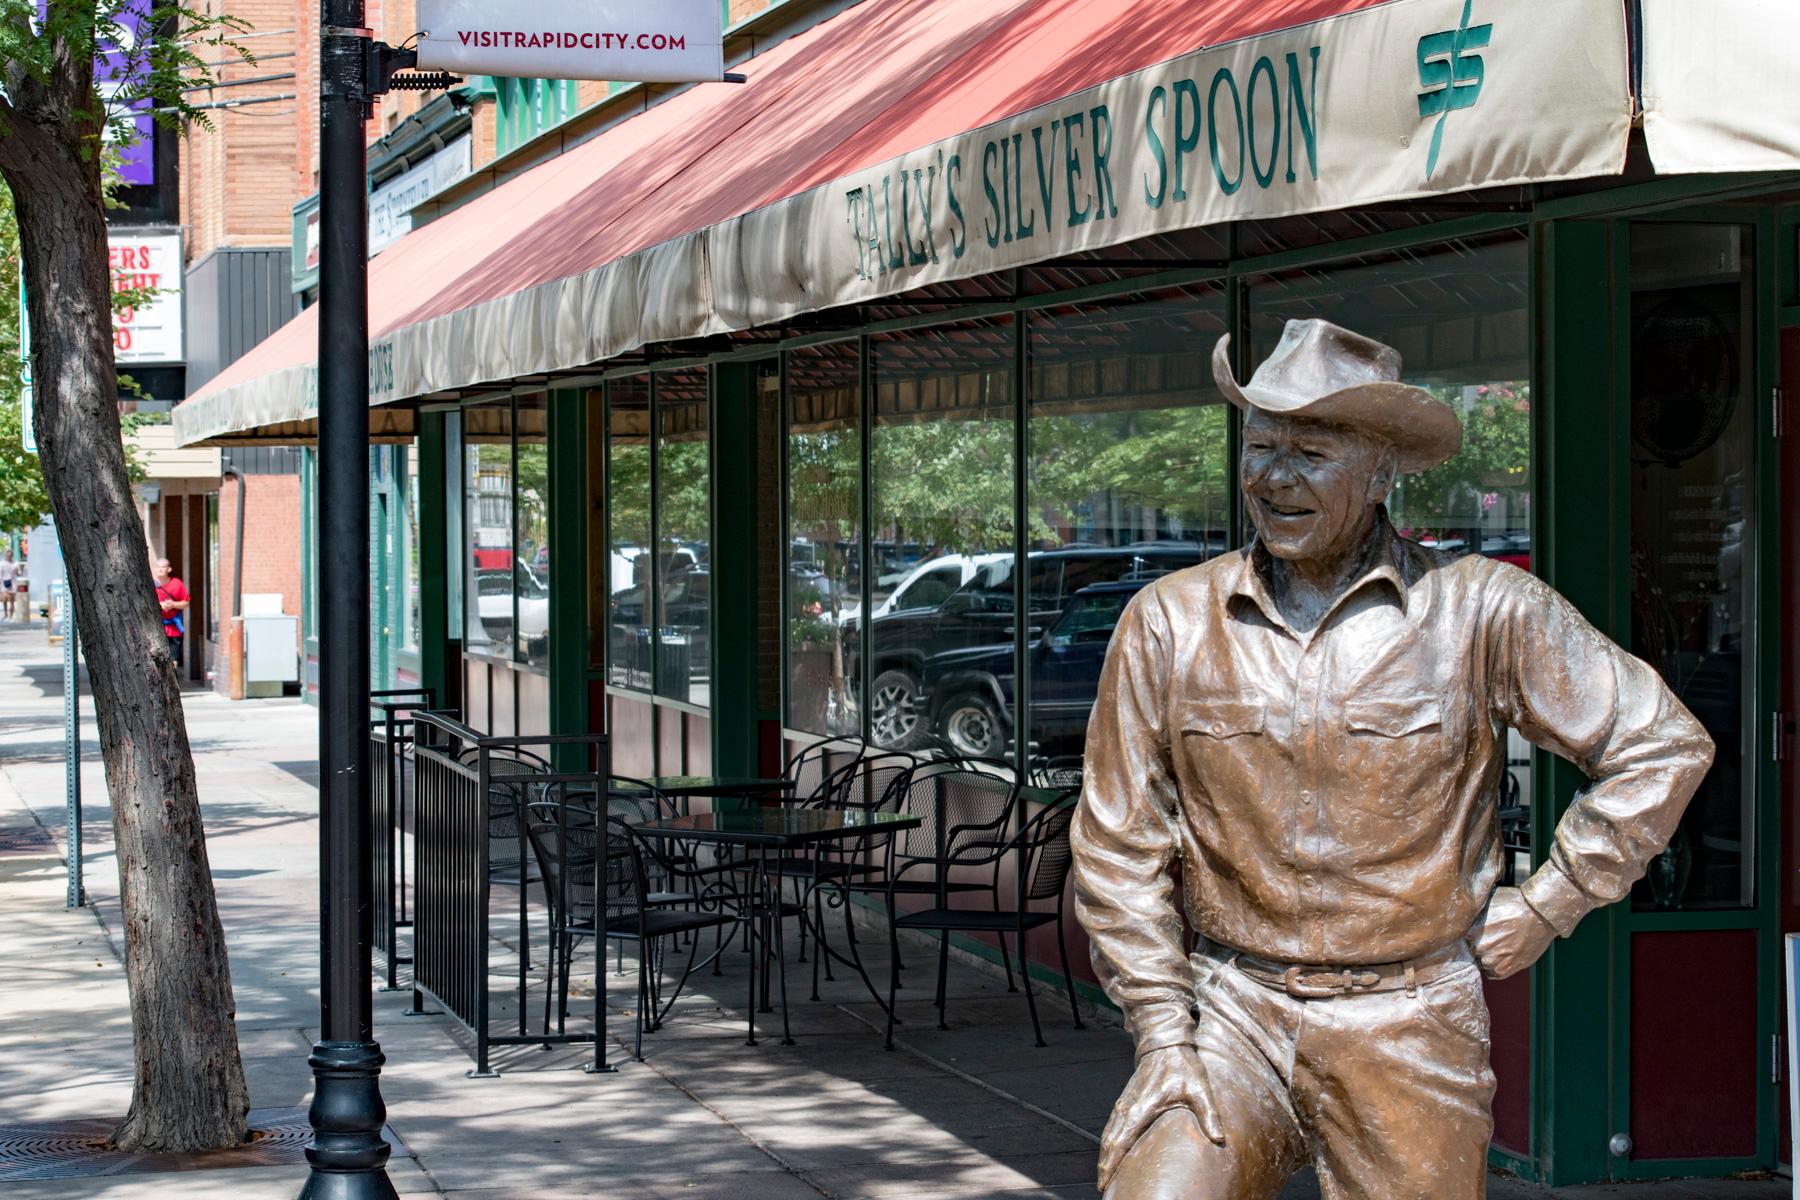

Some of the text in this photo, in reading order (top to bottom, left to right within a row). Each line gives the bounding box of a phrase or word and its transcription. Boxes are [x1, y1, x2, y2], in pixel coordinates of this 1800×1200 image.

[457, 31, 686, 51] VISITRAPIDCITY.COM
[846, 46, 1321, 281] TALLY'S SILVER SPOON
